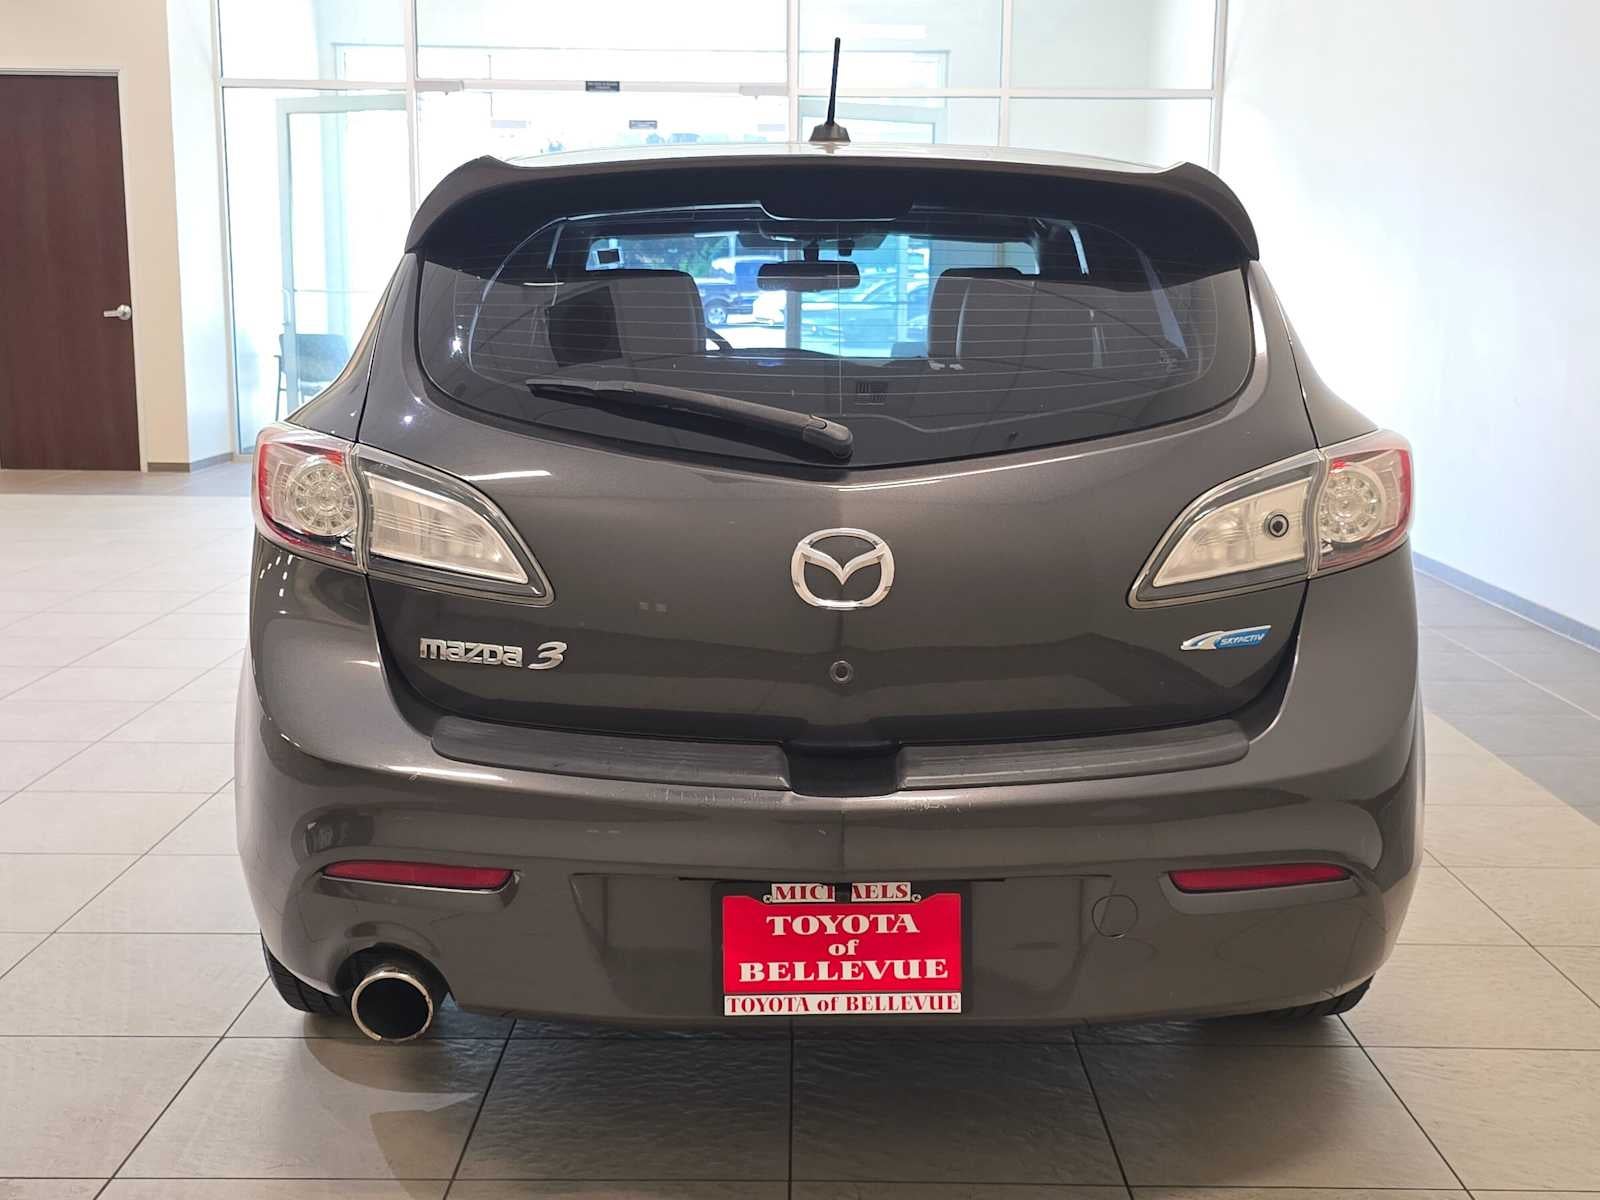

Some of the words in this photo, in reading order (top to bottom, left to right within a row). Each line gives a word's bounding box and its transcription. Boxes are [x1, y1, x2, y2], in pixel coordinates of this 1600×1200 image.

[1220, 633, 1265, 646] SKYACTIV
[420, 638, 523, 667] mazda
[528, 641, 567, 670] 3
[766, 913, 920, 936] TOYOTA
[828, 939, 859, 956] of
[738, 958, 948, 982] BELLEVUE
[727, 996, 809, 1013] TOYOTA
[817, 996, 839, 1012] of
[846, 994, 959, 1012] BELLEVUE
